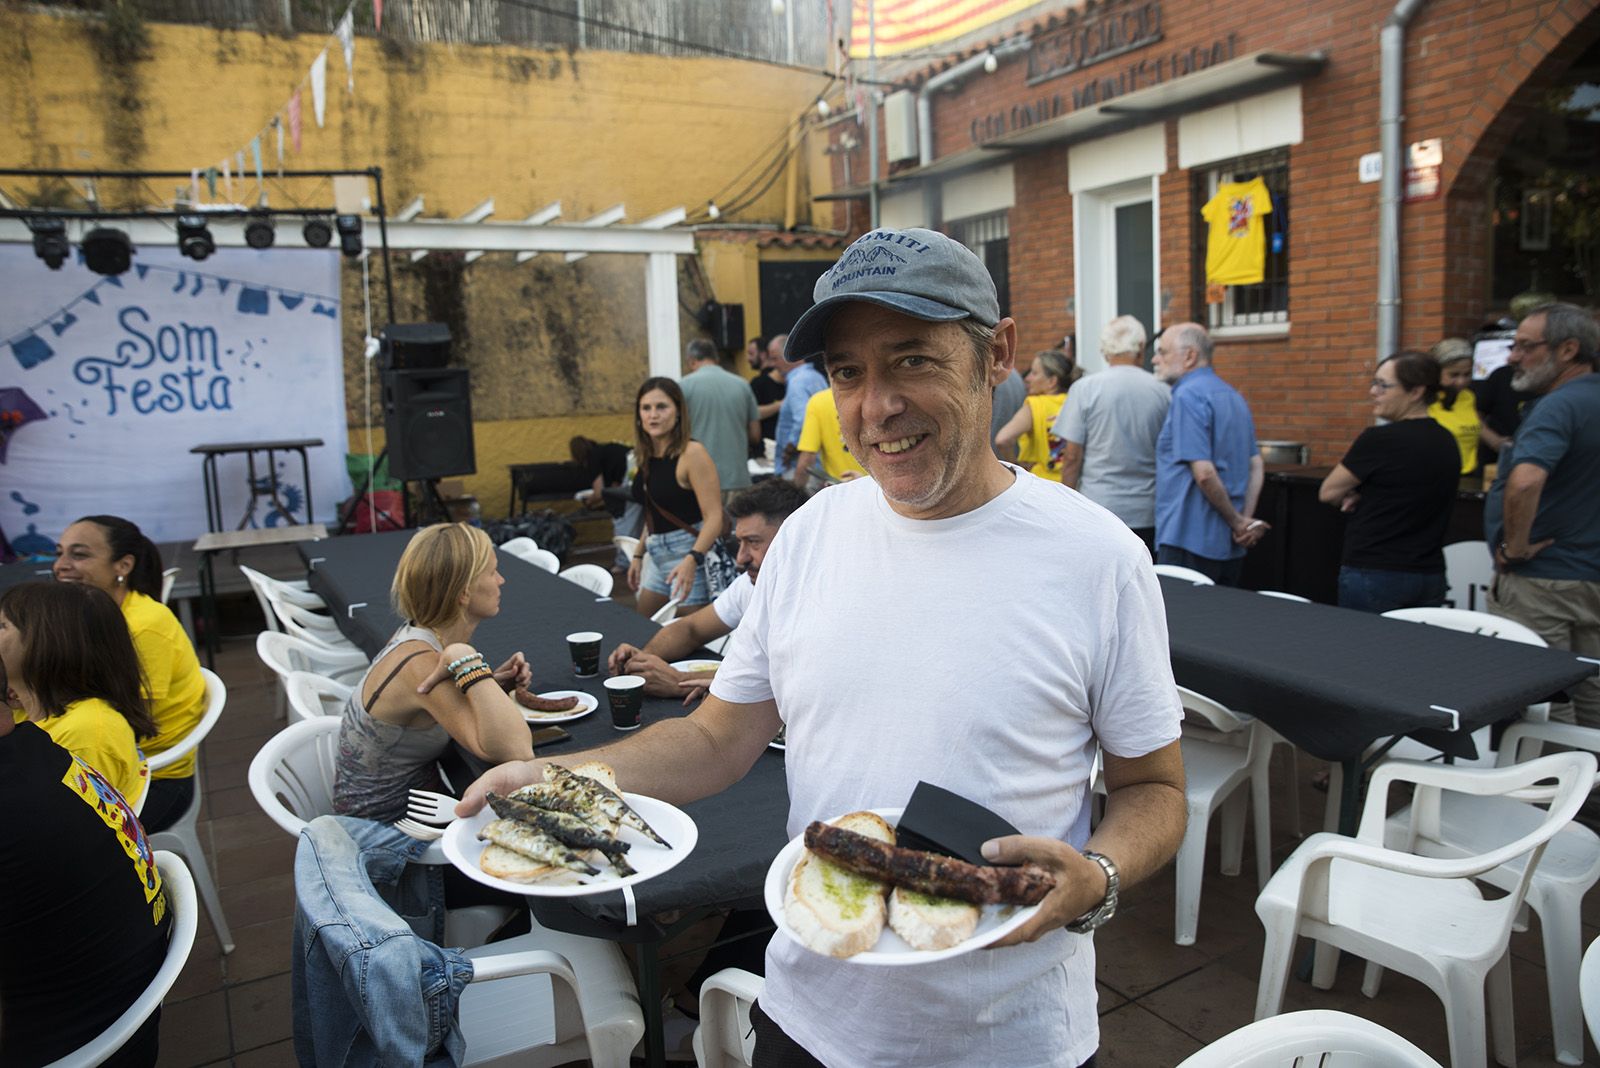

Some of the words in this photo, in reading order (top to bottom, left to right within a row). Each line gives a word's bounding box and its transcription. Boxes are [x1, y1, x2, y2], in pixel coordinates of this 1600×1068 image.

[831, 265, 897, 291] MOUNTAIN
[117, 305, 222, 371] Som
[73, 355, 233, 417] Festa
